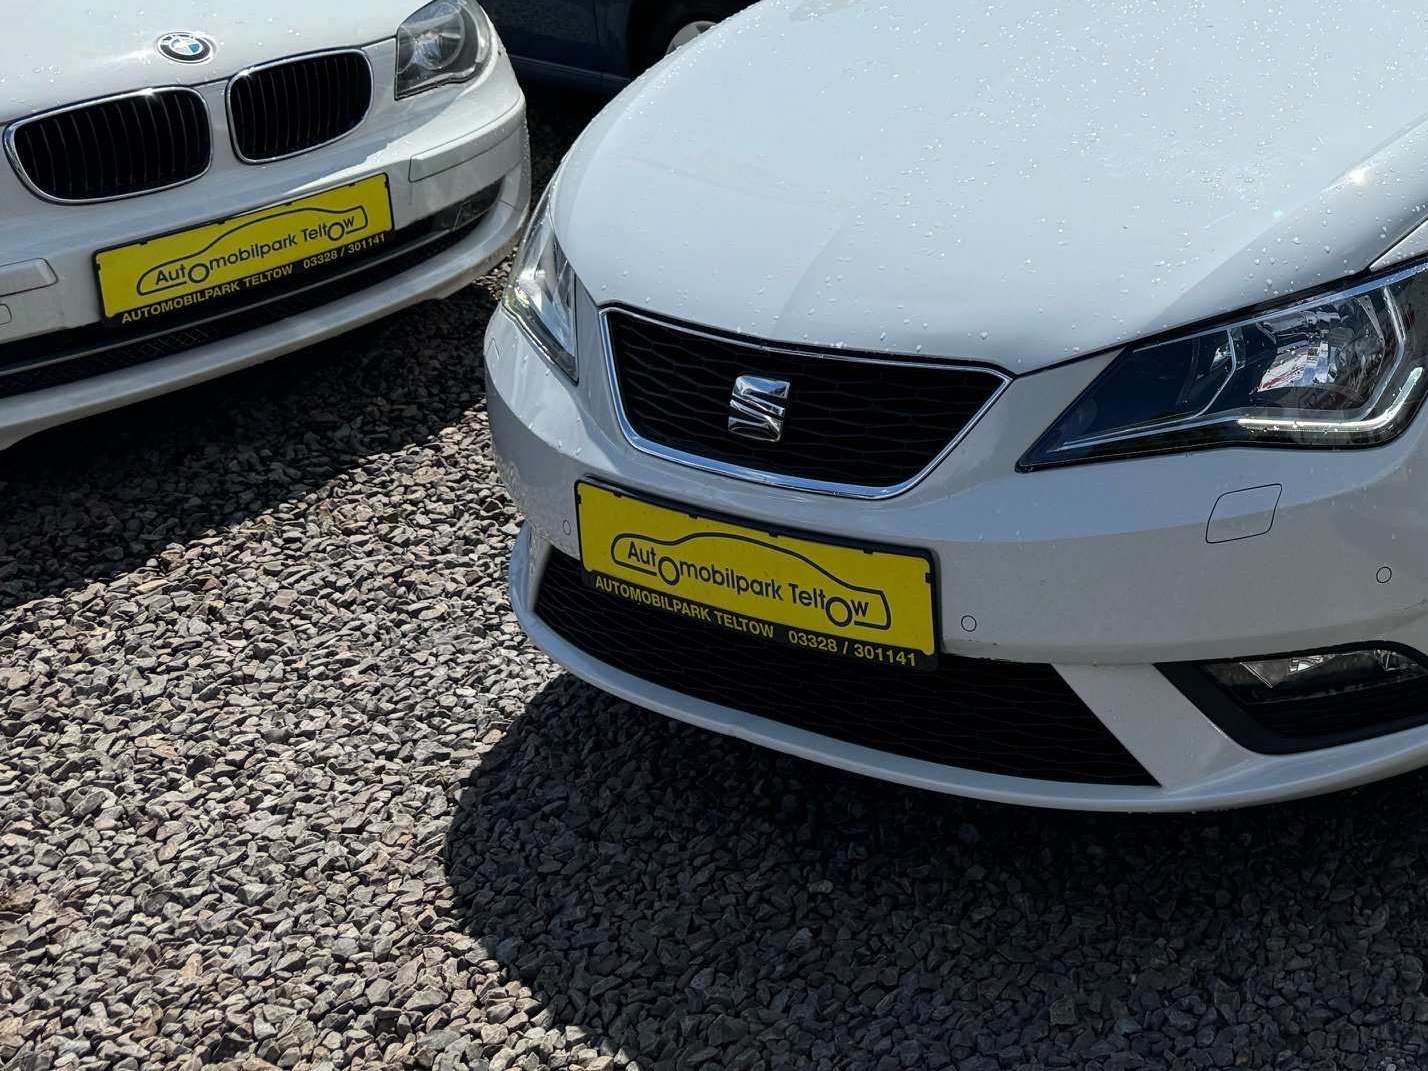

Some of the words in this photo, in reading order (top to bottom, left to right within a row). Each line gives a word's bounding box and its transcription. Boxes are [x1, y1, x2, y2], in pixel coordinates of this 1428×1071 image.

[121, 280, 241, 324] AUTOMOBILPARK
[242, 264, 294, 288] TELTOW
[303, 250, 339, 269] 03328
[348, 233, 386, 255] 301141
[594, 575, 711, 622] AUTOMOBILPARK
[713, 610, 775, 639] TELTOW
[788, 630, 839, 653] 03328
[854, 643, 918, 667] 301141
